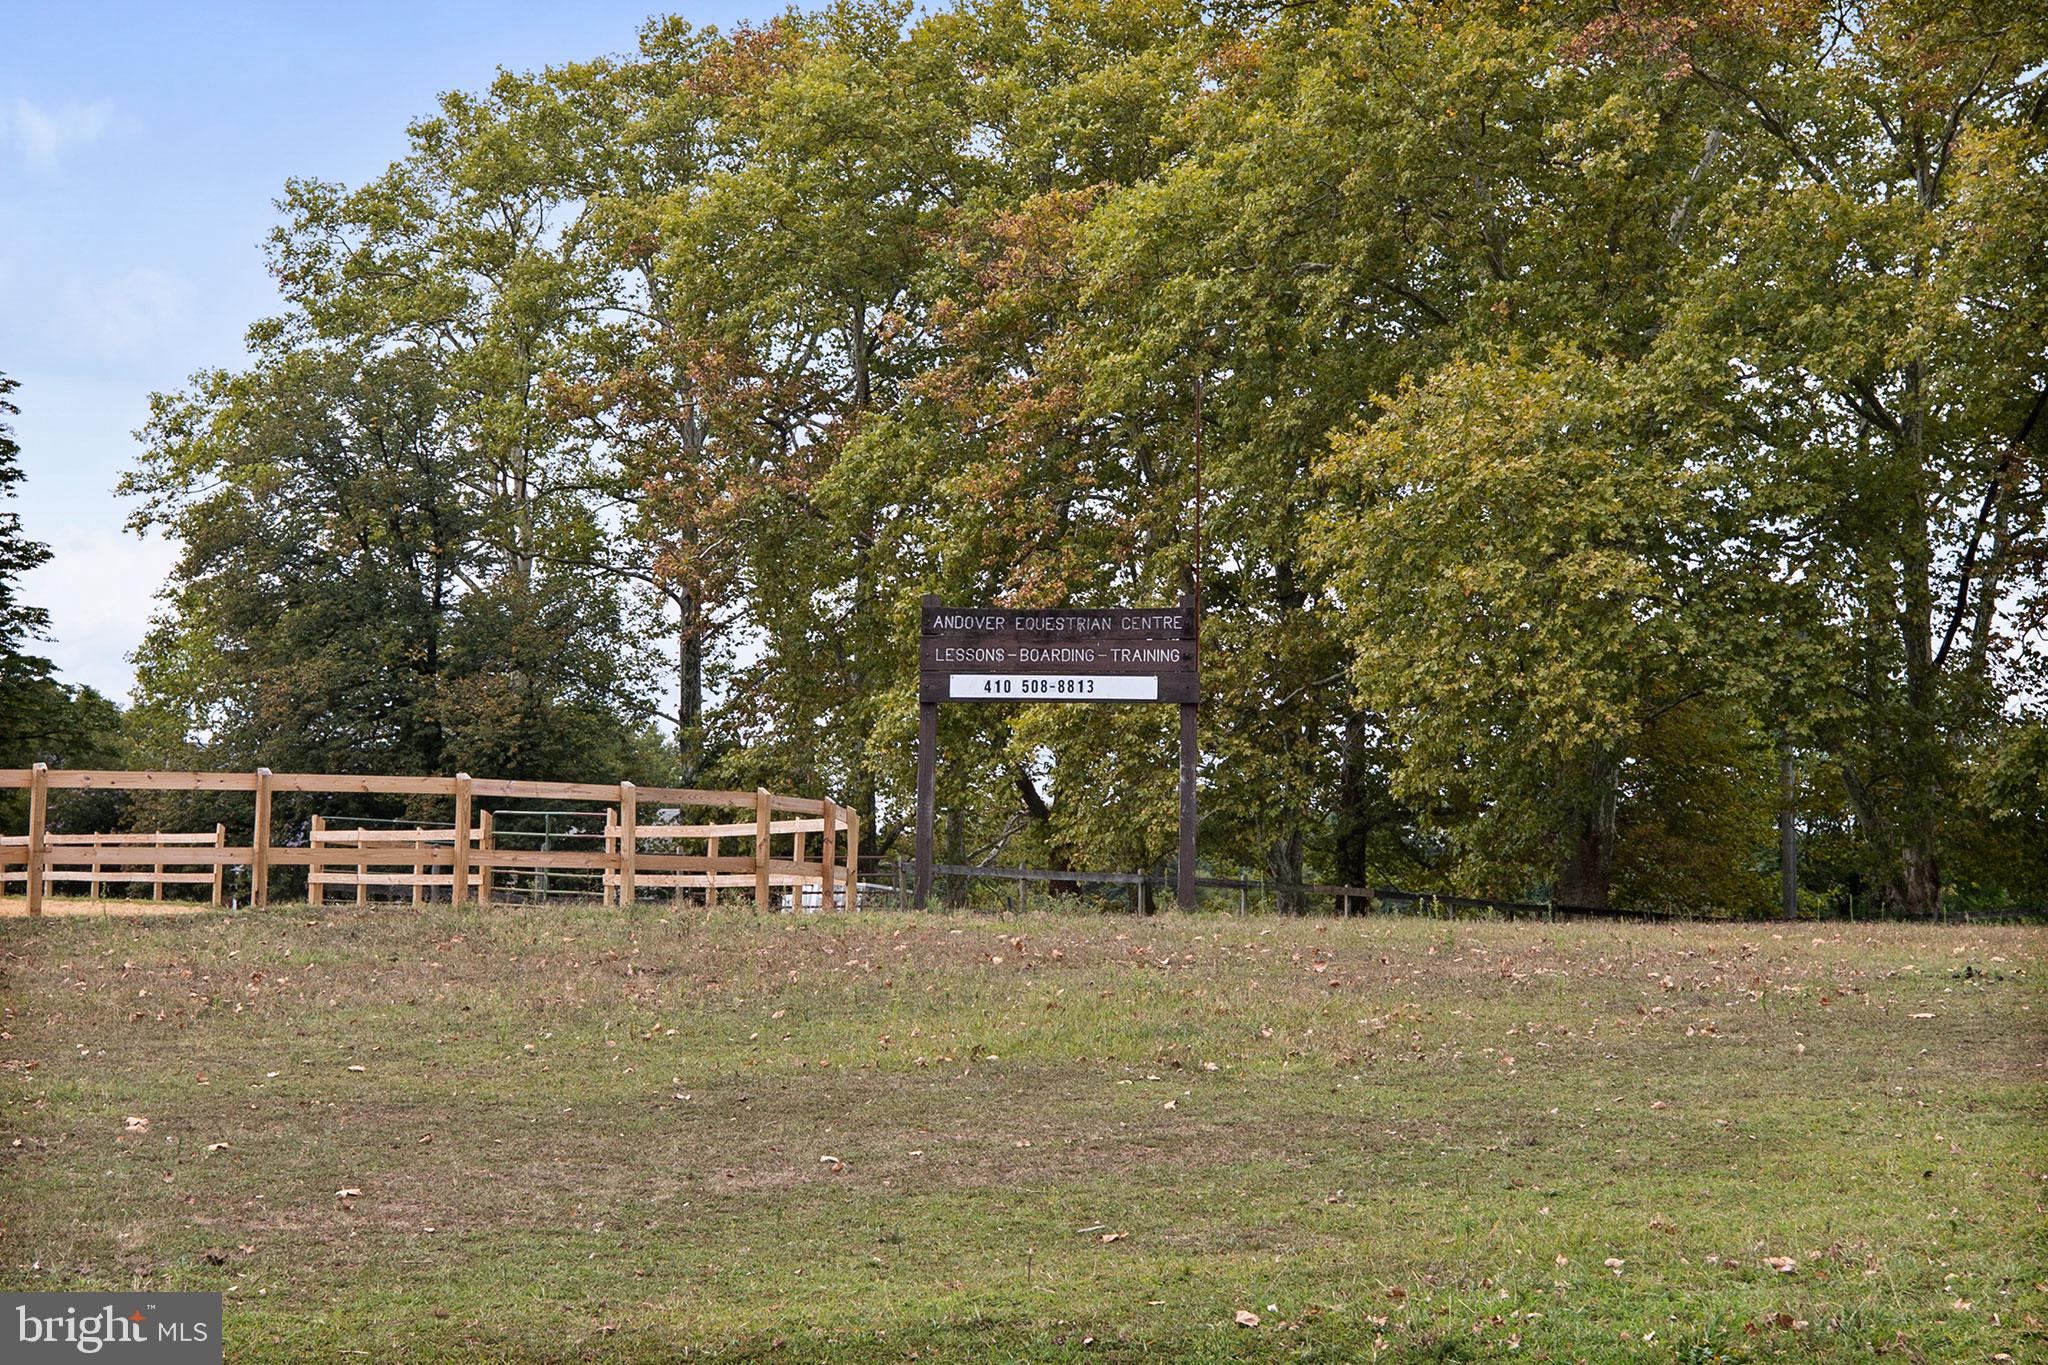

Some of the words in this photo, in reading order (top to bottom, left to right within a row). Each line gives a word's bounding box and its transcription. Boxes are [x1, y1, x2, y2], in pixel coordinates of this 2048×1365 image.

[933, 615, 1005, 630] ANDOVER
[1015, 616, 1112, 632] EQUESTRIAN
[1121, 616, 1183, 630] CENTRE
[984, 680, 1011, 693] 410
[1021, 680, 1094, 693] 508-8813
